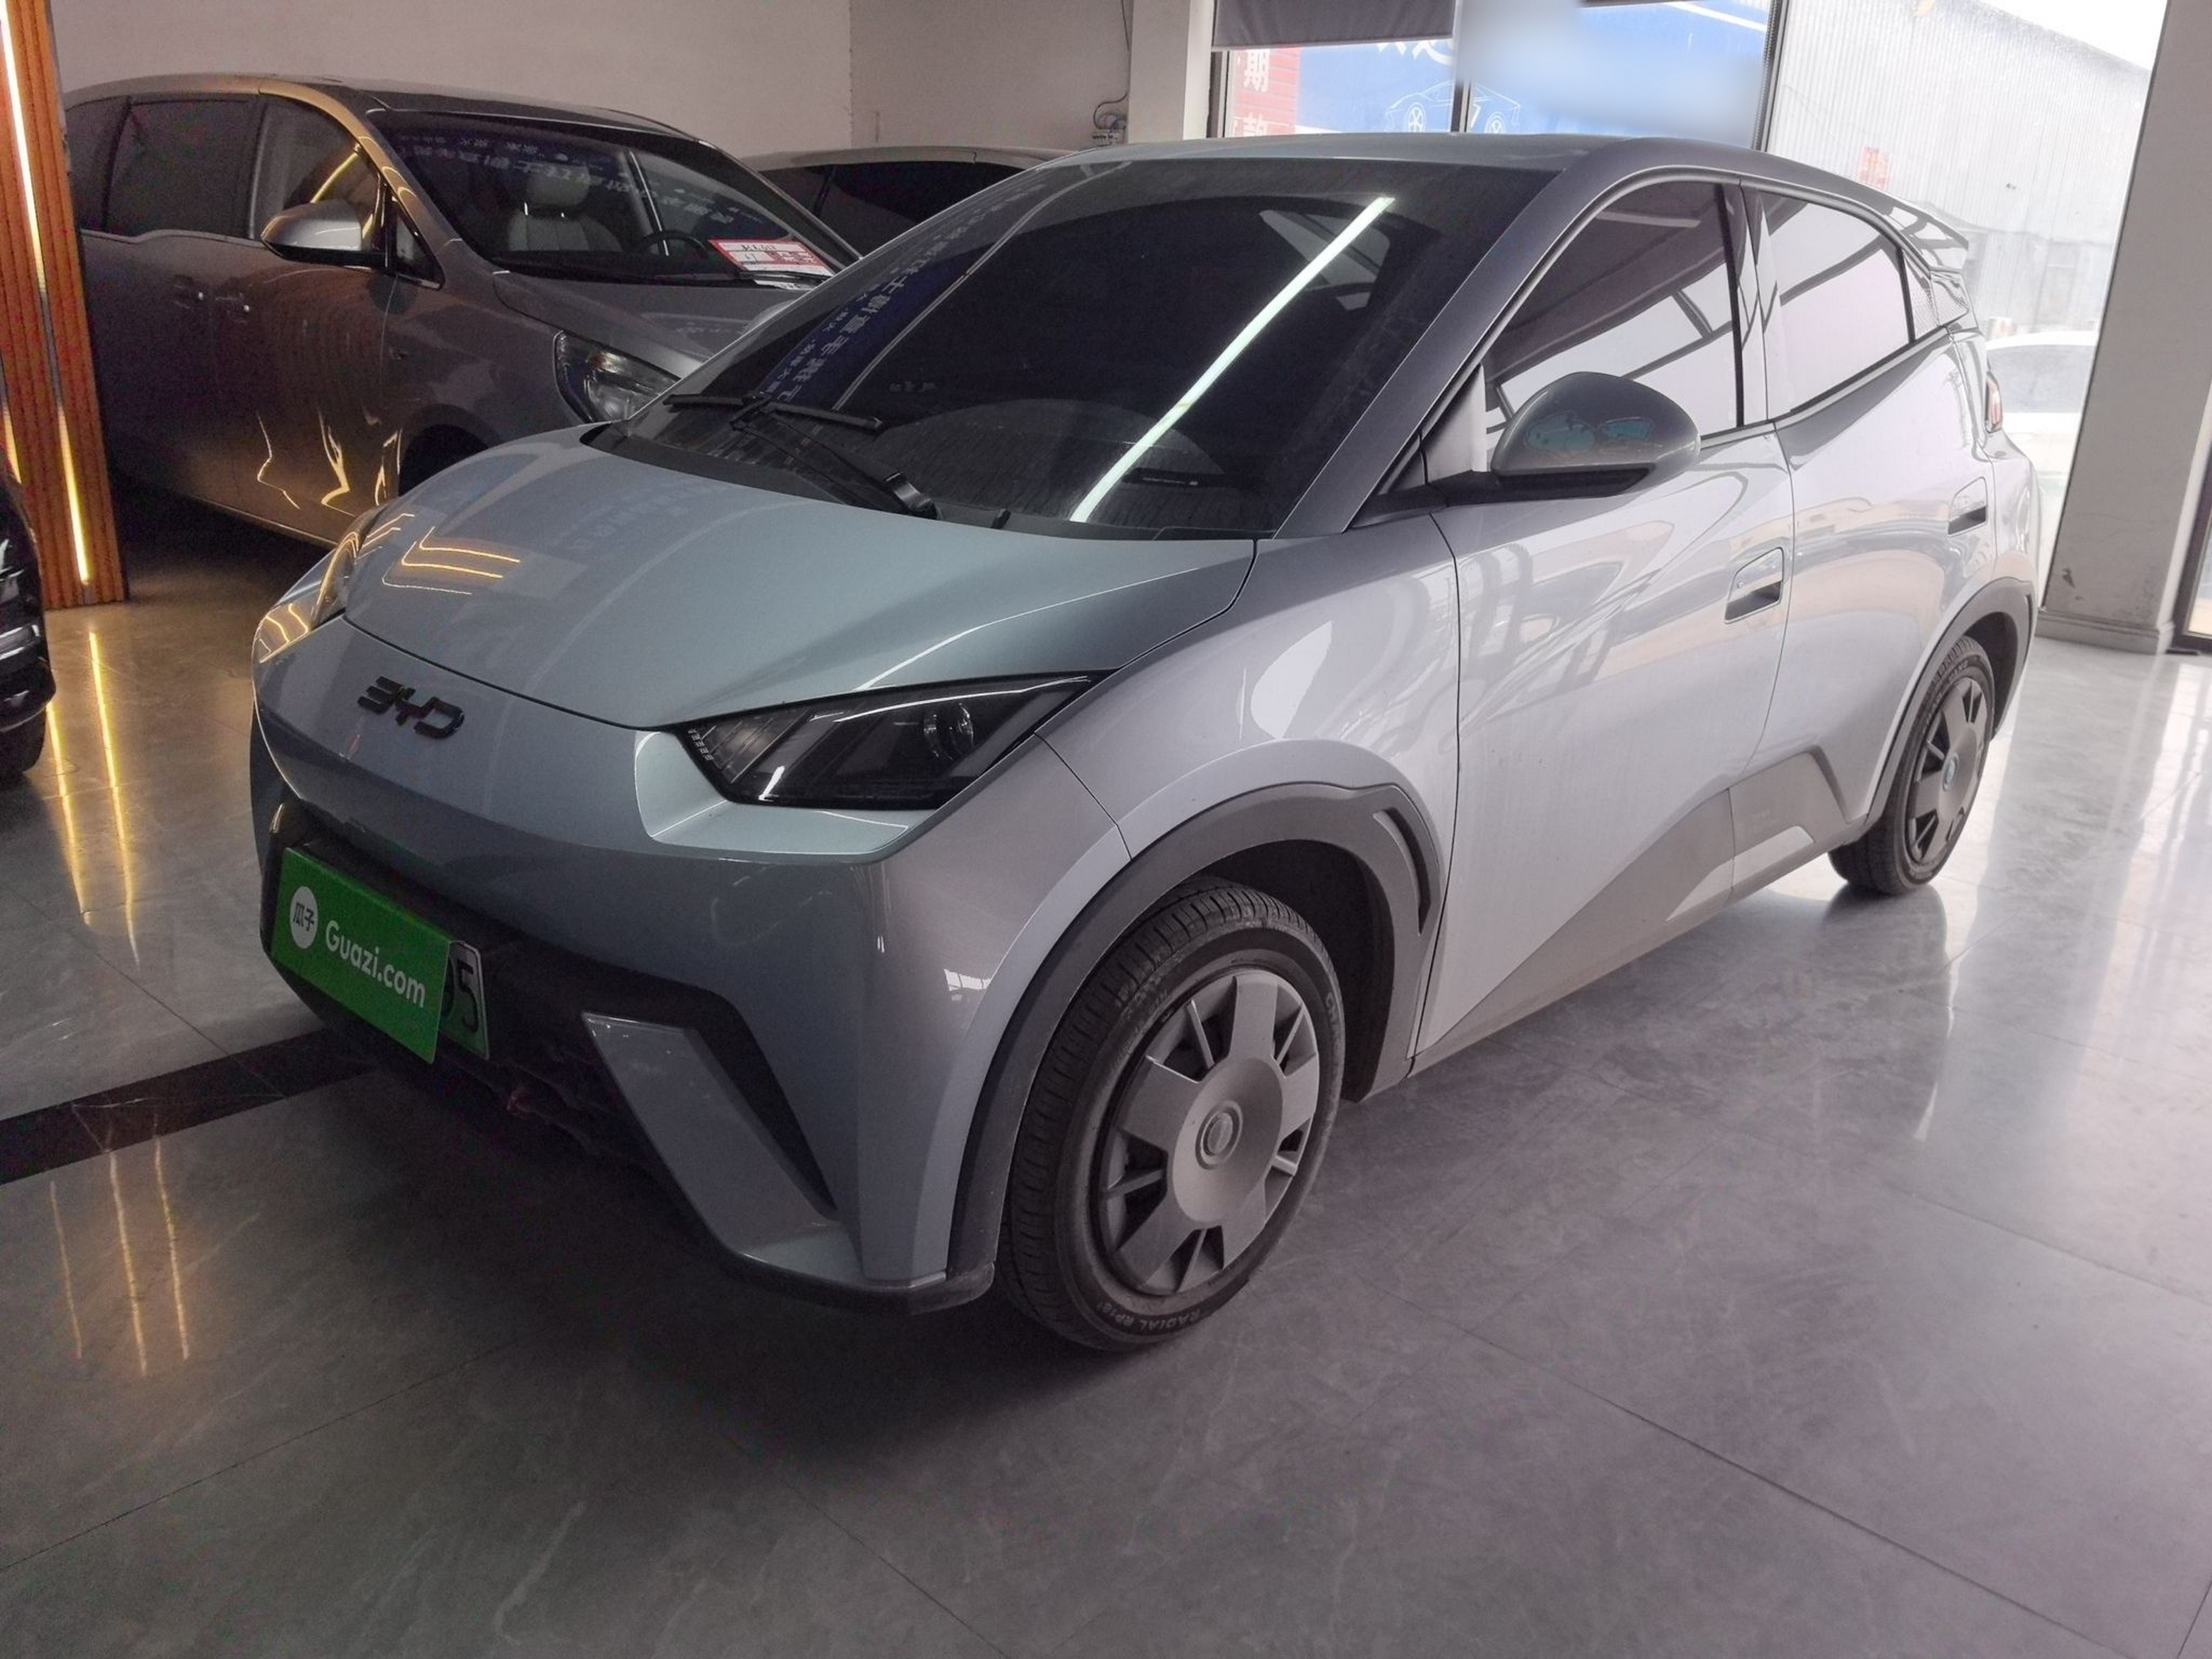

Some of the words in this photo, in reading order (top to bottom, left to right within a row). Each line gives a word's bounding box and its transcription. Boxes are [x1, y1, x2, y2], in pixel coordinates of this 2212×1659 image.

[358, 676, 465, 739] BYD
[293, 904, 315, 932] 瓜子
[325, 921, 426, 1008] Guazi.com
[1139, 1308, 1201, 1331] RADIAL
